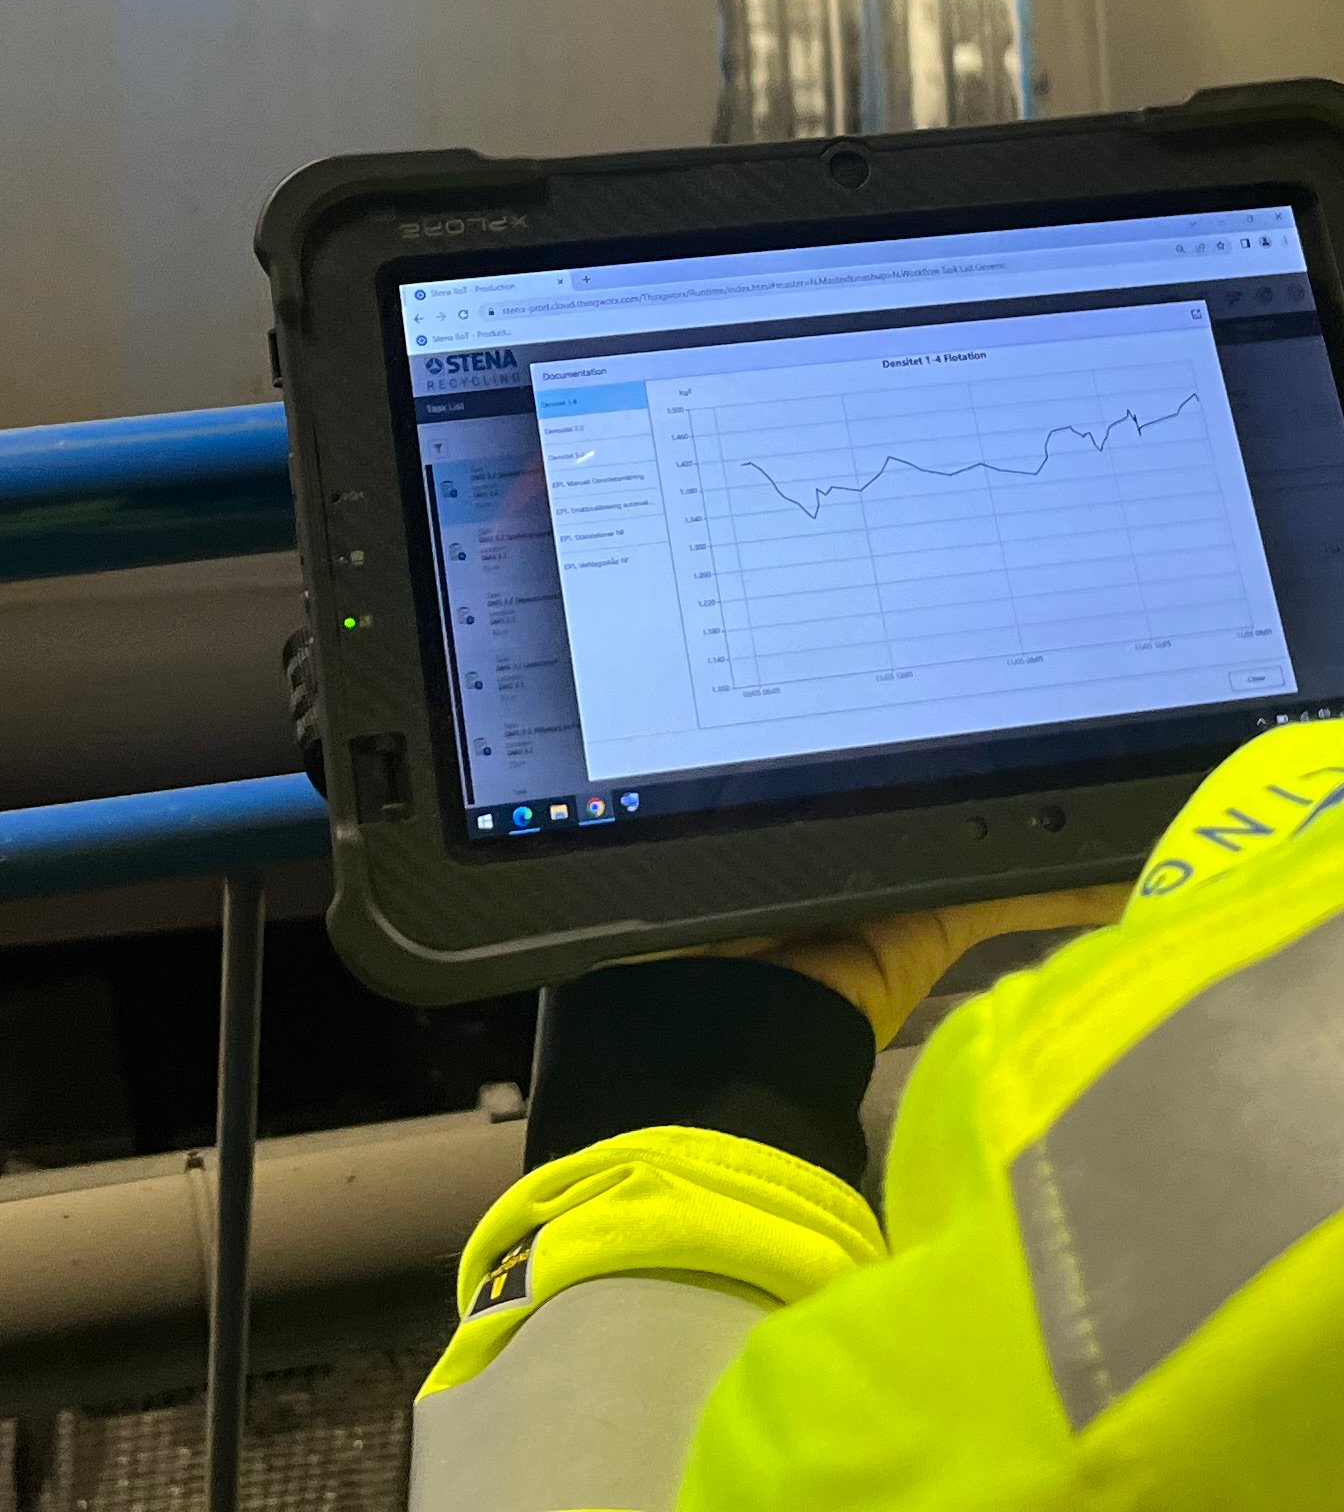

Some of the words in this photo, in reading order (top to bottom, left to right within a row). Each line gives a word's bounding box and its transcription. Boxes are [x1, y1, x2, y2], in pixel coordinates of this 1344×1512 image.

[446, 349, 518, 375] STENA
[882, 357, 923, 369] Densitet
[944, 351, 987, 363] Flotation
[426, 372, 521, 392] RECYCLING
[543, 368, 607, 381] Documentation
